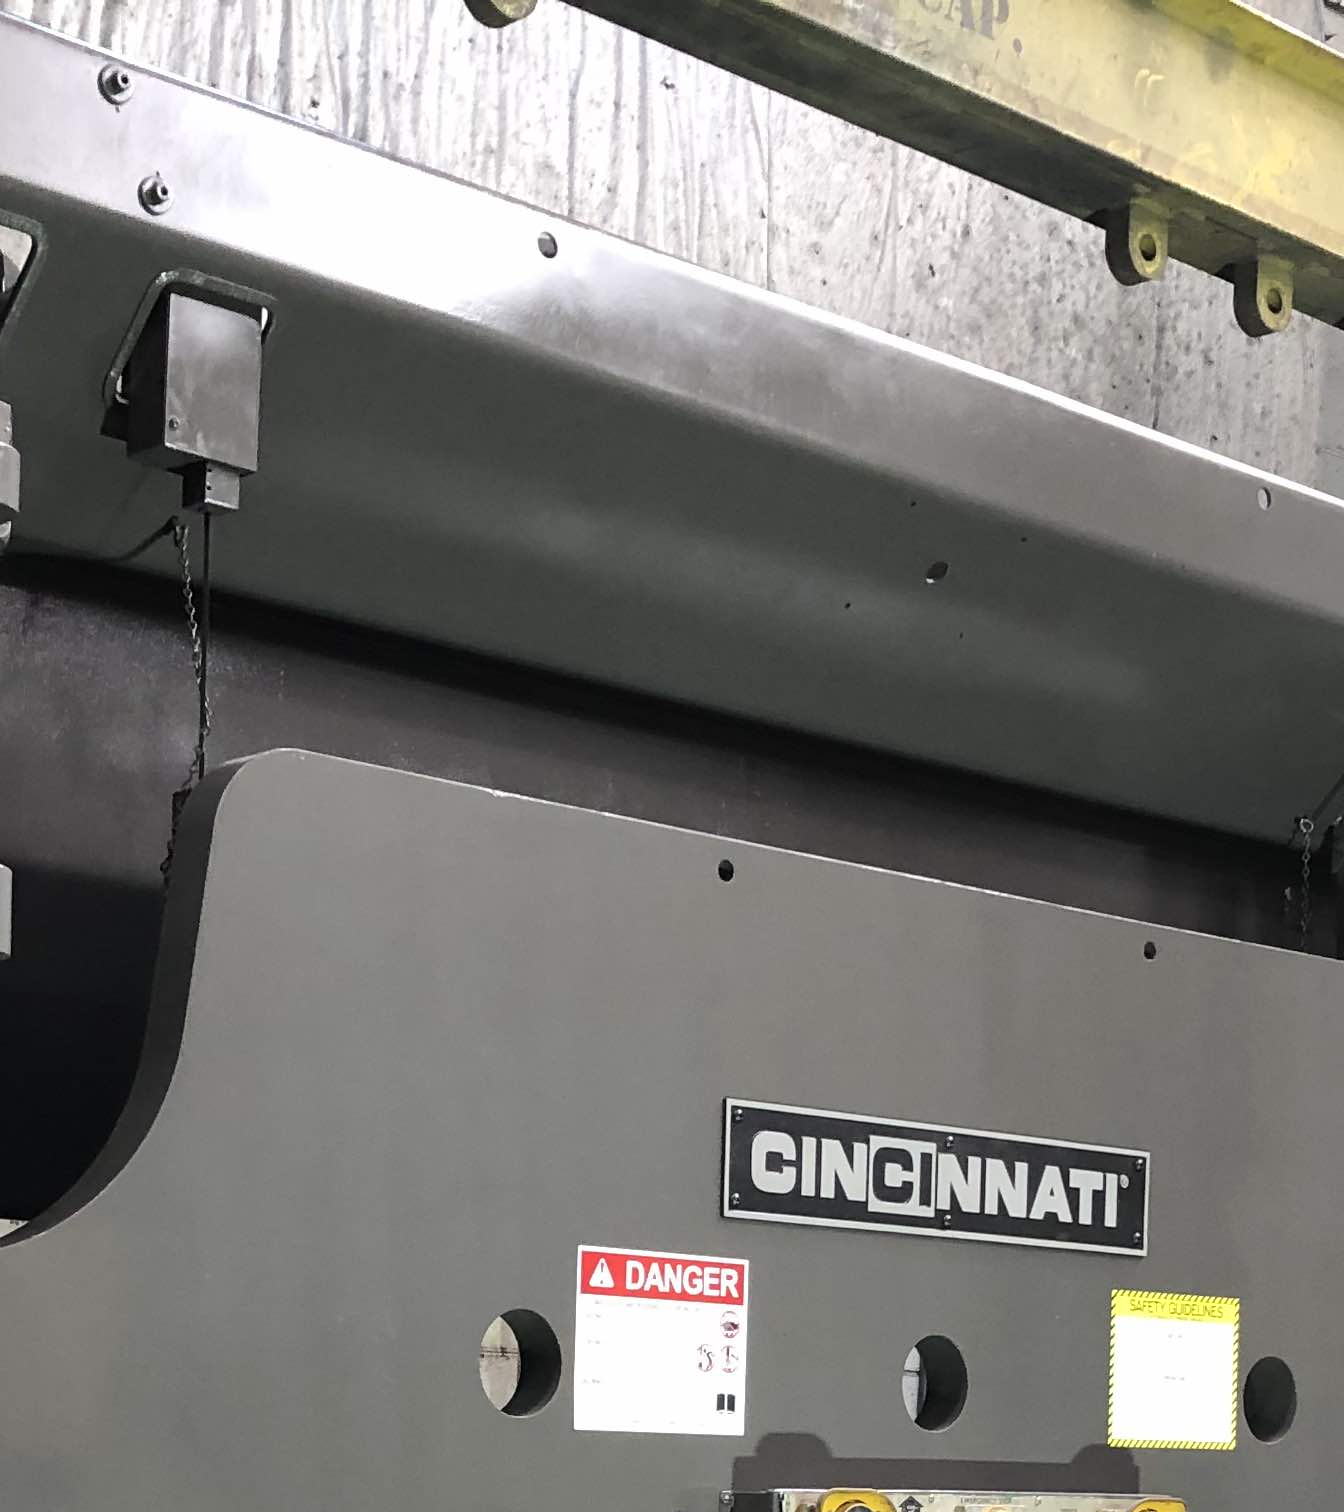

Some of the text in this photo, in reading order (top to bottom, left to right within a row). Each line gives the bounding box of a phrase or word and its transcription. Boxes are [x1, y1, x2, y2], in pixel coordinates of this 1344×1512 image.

[751, 1130, 1119, 1228] CINCINNATI
[624, 1259, 739, 1299] DANGER
[1129, 1298, 1167, 1314] SAFETY
[1168, 1302, 1224, 1319] GUIDELINES
